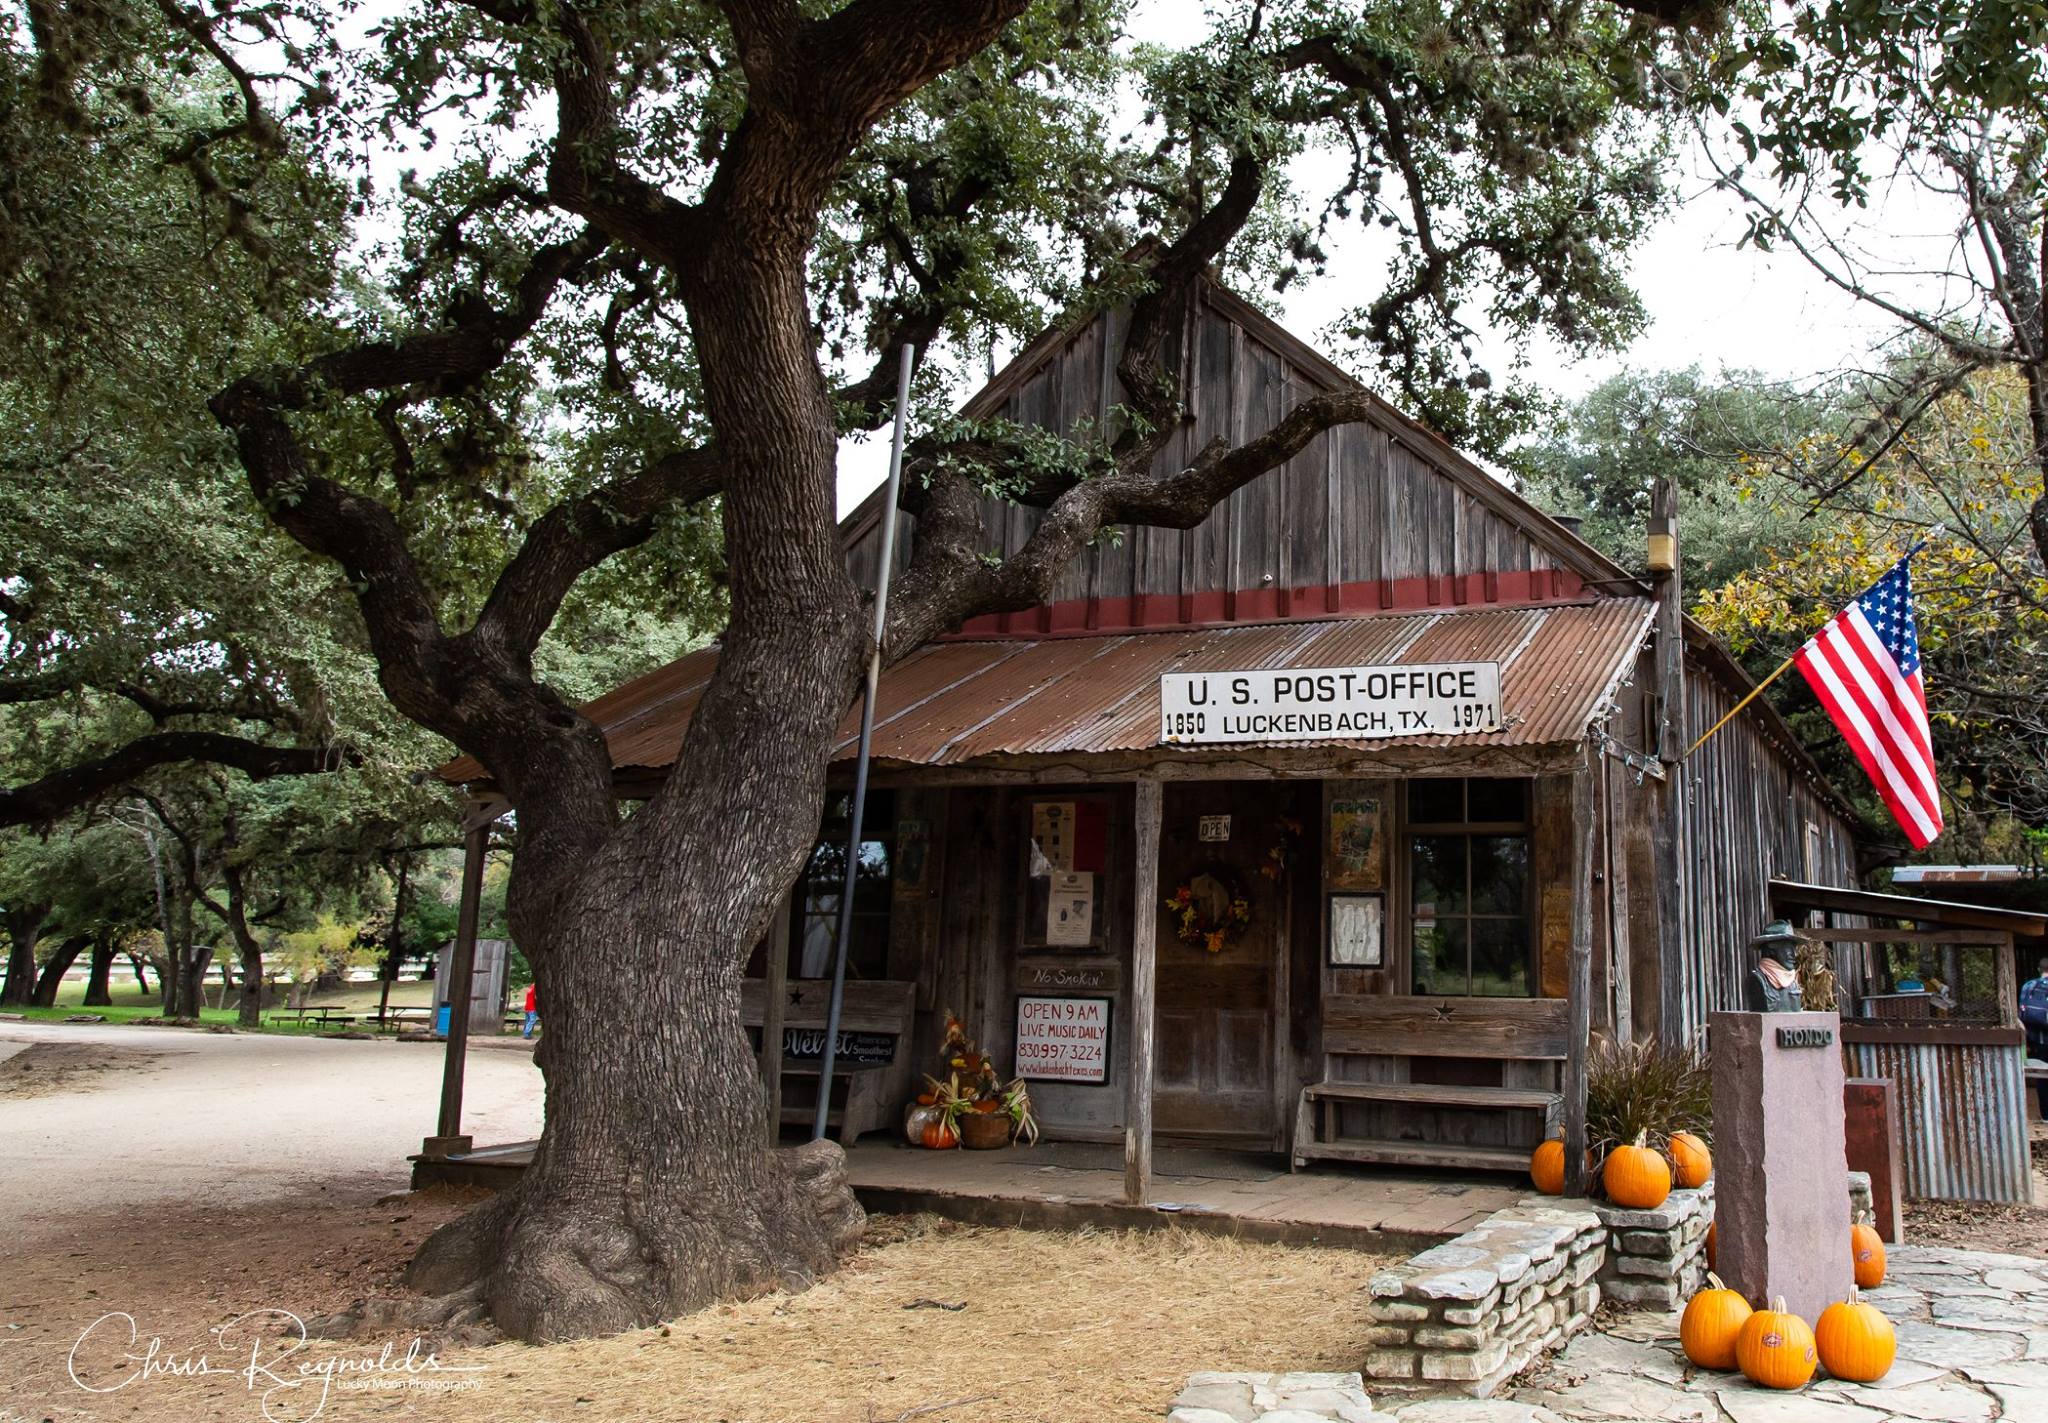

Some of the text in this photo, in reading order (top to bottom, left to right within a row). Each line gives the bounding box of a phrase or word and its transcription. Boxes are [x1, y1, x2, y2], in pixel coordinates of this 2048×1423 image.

[1188, 670, 1476, 705] U. S. POST-OFFICE
[1166, 712, 1205, 735] 1850
[1453, 704, 1495, 727] 1971
[1202, 821, 1229, 836] OPEN
[1023, 1003, 1099, 1020] OPEN 9 AM
[1020, 1023, 1106, 1040] LIVE MUSIC DAILY
[1778, 1028, 1833, 1047] HONDO
